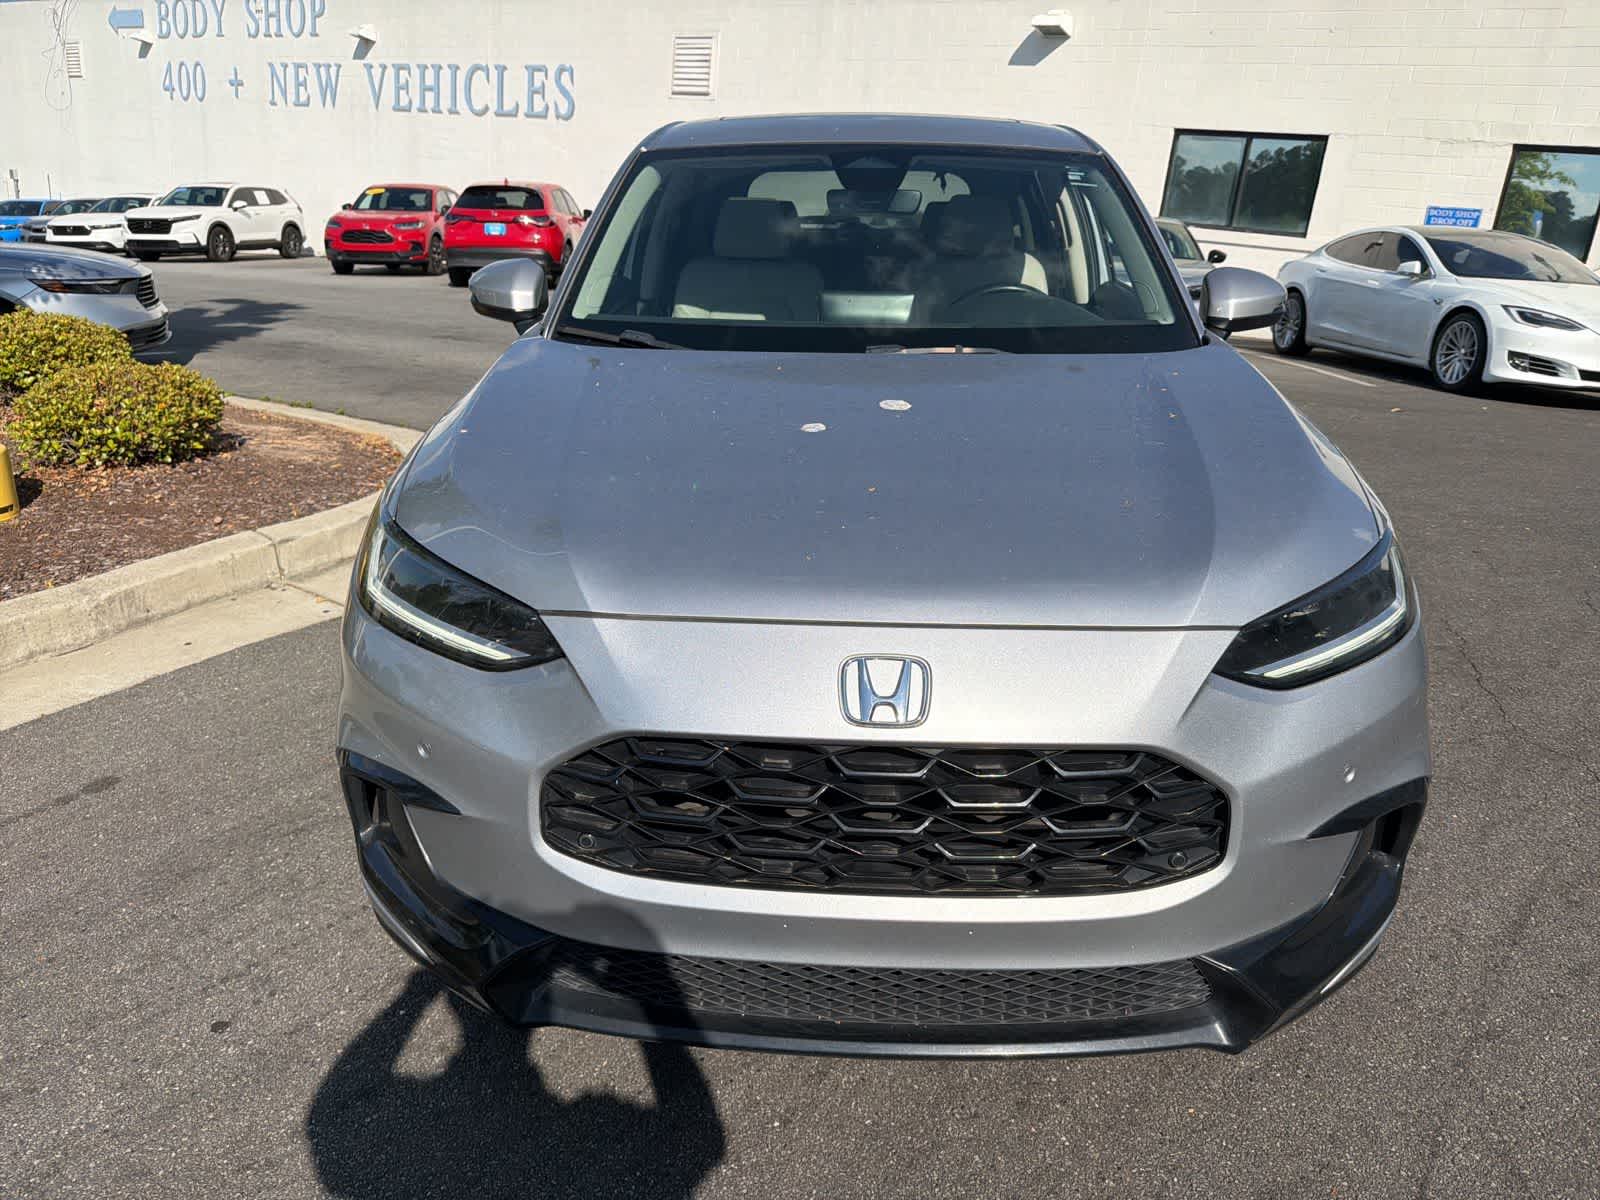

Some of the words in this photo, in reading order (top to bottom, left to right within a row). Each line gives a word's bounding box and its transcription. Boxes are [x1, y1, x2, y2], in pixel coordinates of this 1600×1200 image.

[156, 0, 226, 39] BODY
[245, 0, 326, 39] SHOP
[162, 60, 207, 103] 400
[268, 62, 342, 109] NEW
[362, 62, 576, 121] VEHICLES
[1429, 208, 1454, 217] BODY
[1455, 210, 1479, 219] SHOP
[1430, 216, 1456, 225] DROP
[1456, 218, 1474, 227] OFF
